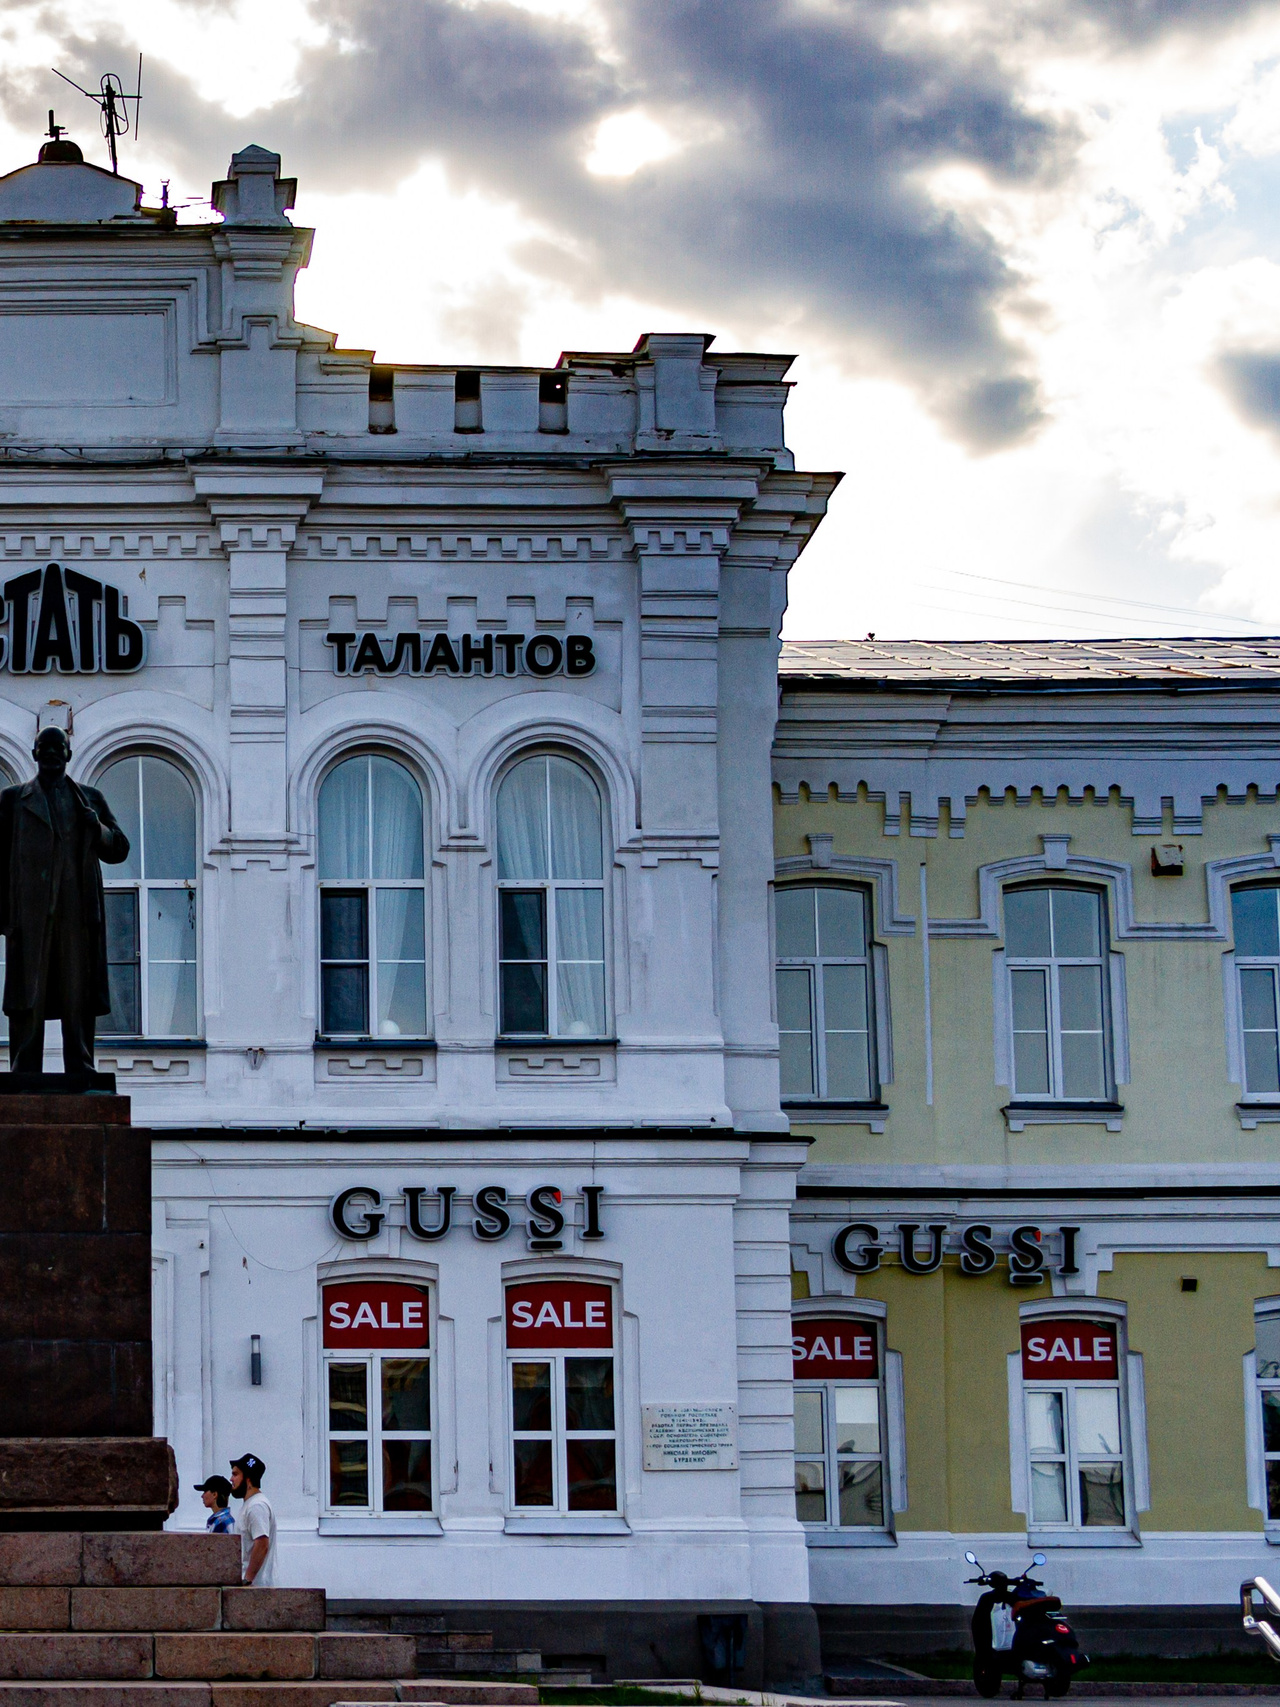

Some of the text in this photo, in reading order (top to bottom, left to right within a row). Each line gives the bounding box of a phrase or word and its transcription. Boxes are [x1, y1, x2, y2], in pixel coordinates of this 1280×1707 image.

[327, 633, 596, 675] ТАЛАНТОВ
[332, 1186, 604, 1248] GUSSI
[834, 1223, 1080, 1283] GUSSI
[329, 1301, 423, 1329] SALE
[512, 1301, 606, 1328] SALE
[791, 1336, 873, 1361] SALE
[1027, 1337, 1112, 1361] SALE
